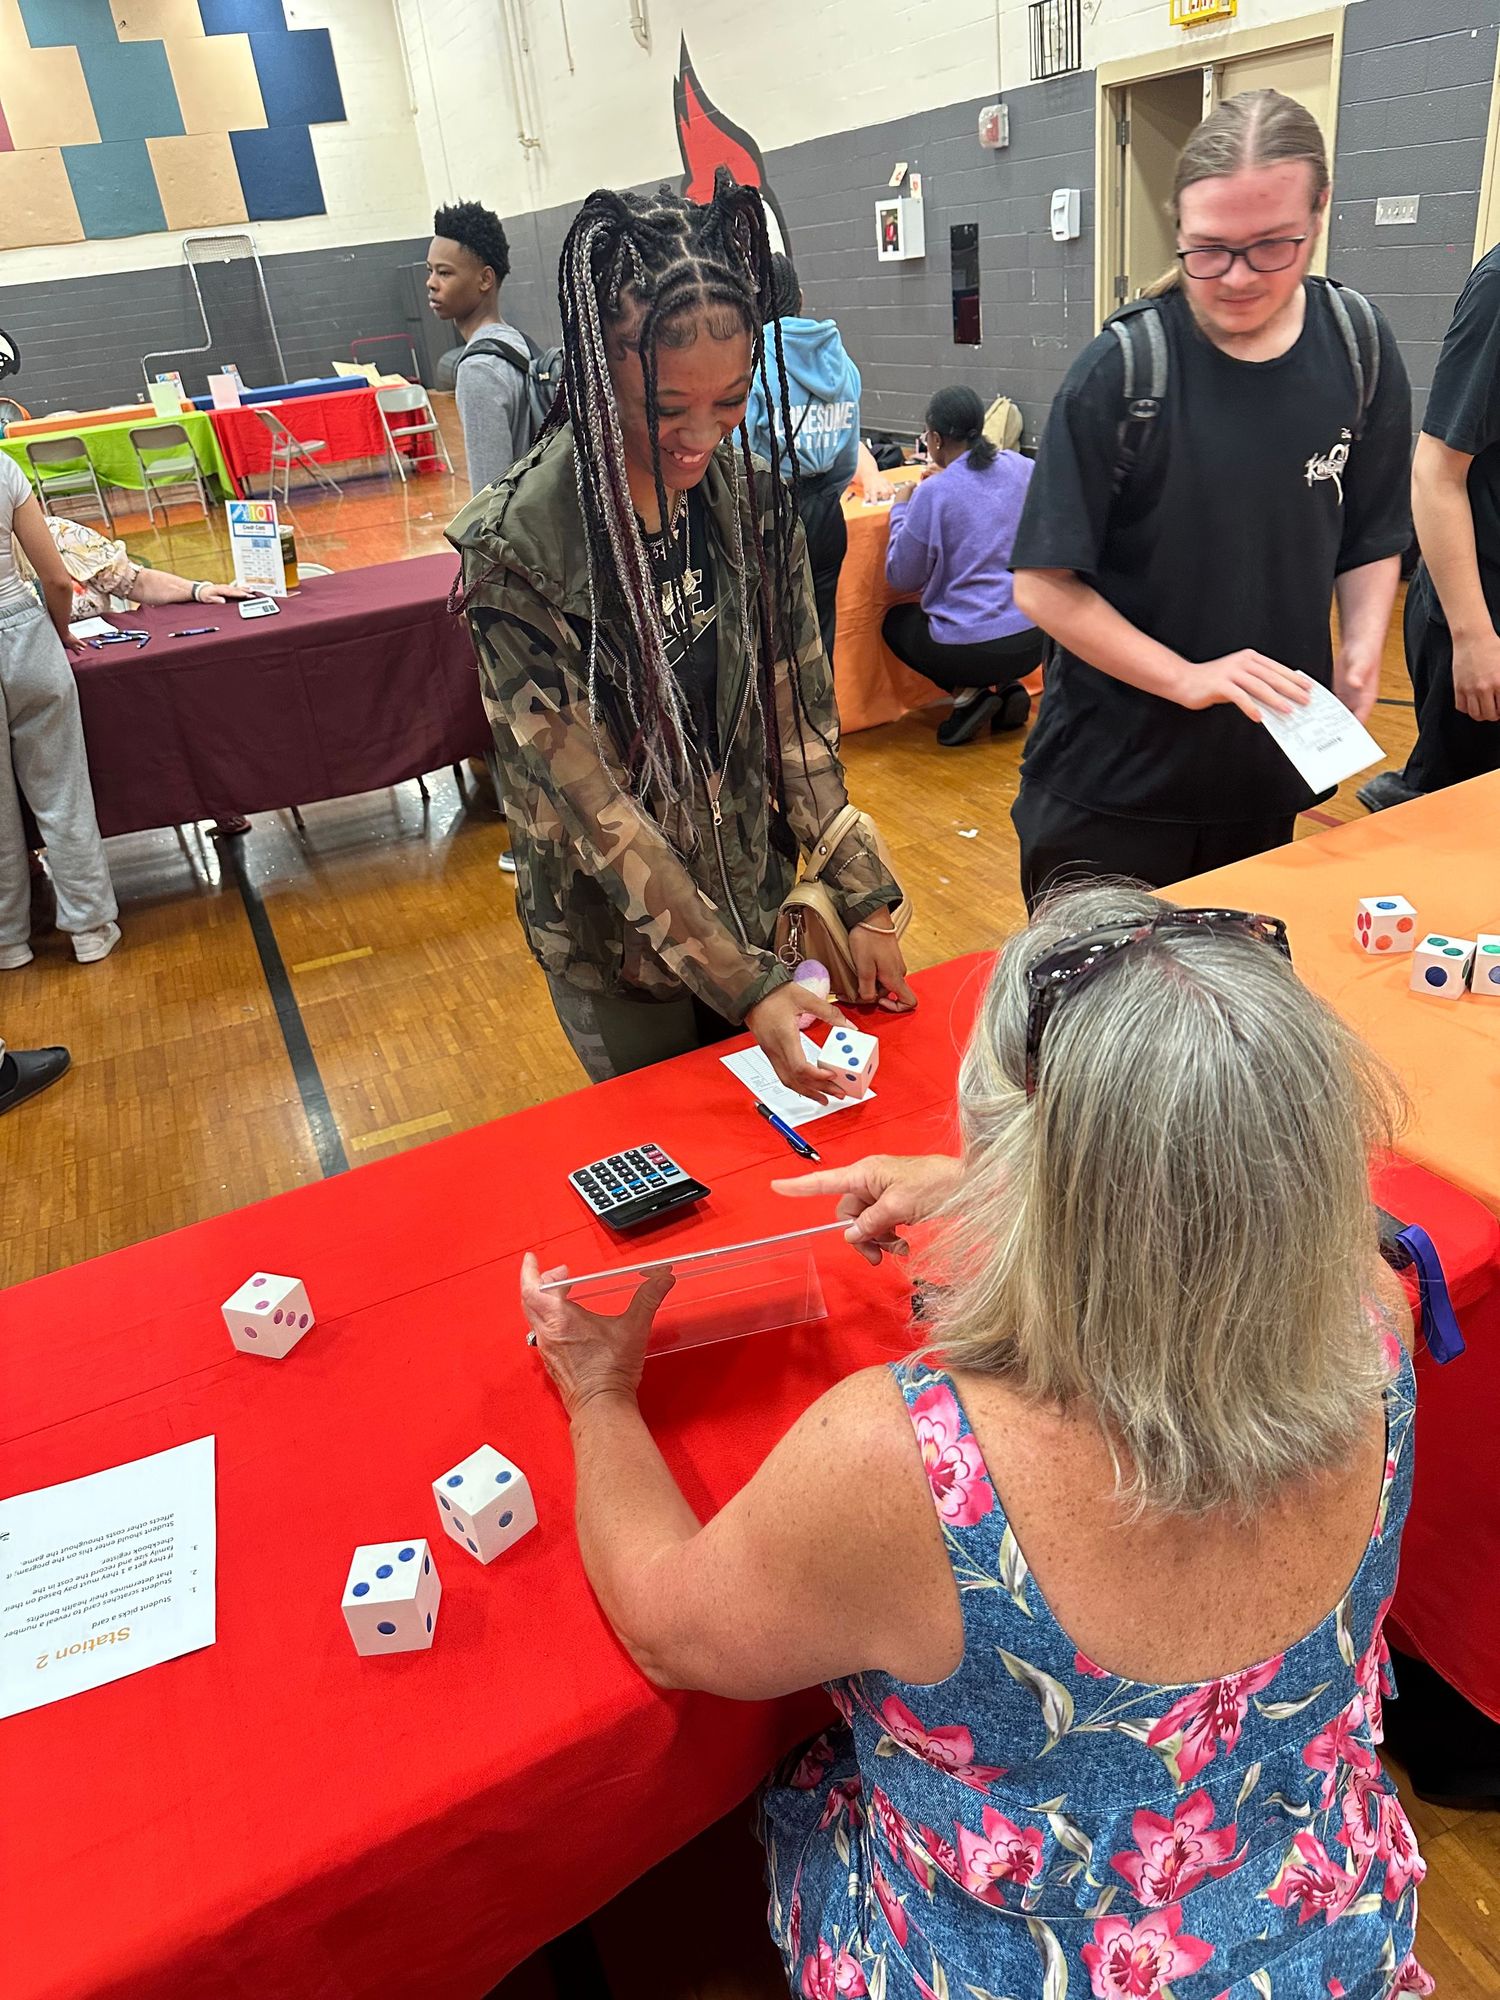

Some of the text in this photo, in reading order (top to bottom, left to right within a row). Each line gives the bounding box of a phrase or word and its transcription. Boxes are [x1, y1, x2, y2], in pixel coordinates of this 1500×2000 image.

[149, 1513, 174, 1525] affects
[127, 1521, 148, 1532] other
[144, 1520, 174, 1535] Student
[105, 1530, 125, 1539] costs
[117, 1530, 143, 1545] should
[61, 1535, 104, 1554] throughout
[94, 1540, 115, 1551] enter
[133, 1537, 174, 1555] checkbook
[46, 1550, 58, 1558] the
[79, 1547, 93, 1557] this
[150, 1545, 174, 1556] family
[52, 1556, 64, 1565] the
[134, 1553, 148, 1561] size
[148, 1553, 166, 1565] they
[118, 1558, 133, 1568] and
[134, 1561, 147, 1570] get
[90, 1564, 116, 1577] record
[101, 1570, 119, 1582] they
[57, 1578, 73, 1587] cost
[75, 1573, 88, 1583] the
[80, 1577, 99, 1588] must
[32, 1586, 46, 1595] the
[64, 1583, 78, 1592] pay
[141, 1578, 172, 1593] Student
[25, 1597, 36, 1605] on
[26, 1570, 172, 1623] that determines their health benefits
[38, 1589, 62, 1602] based
[103, 1589, 139, 1605] scratches
[4, 1602, 24, 1612] their
[83, 1602, 101, 1613] card
[140, 1596, 171, 1611] Student
[118, 1606, 138, 1618] picks
[46, 1612, 71, 1626] reveal
[92, 1617, 109, 1629] card
[4, 1625, 37, 1638] number
[36, 1627, 130, 1669] Station 2
